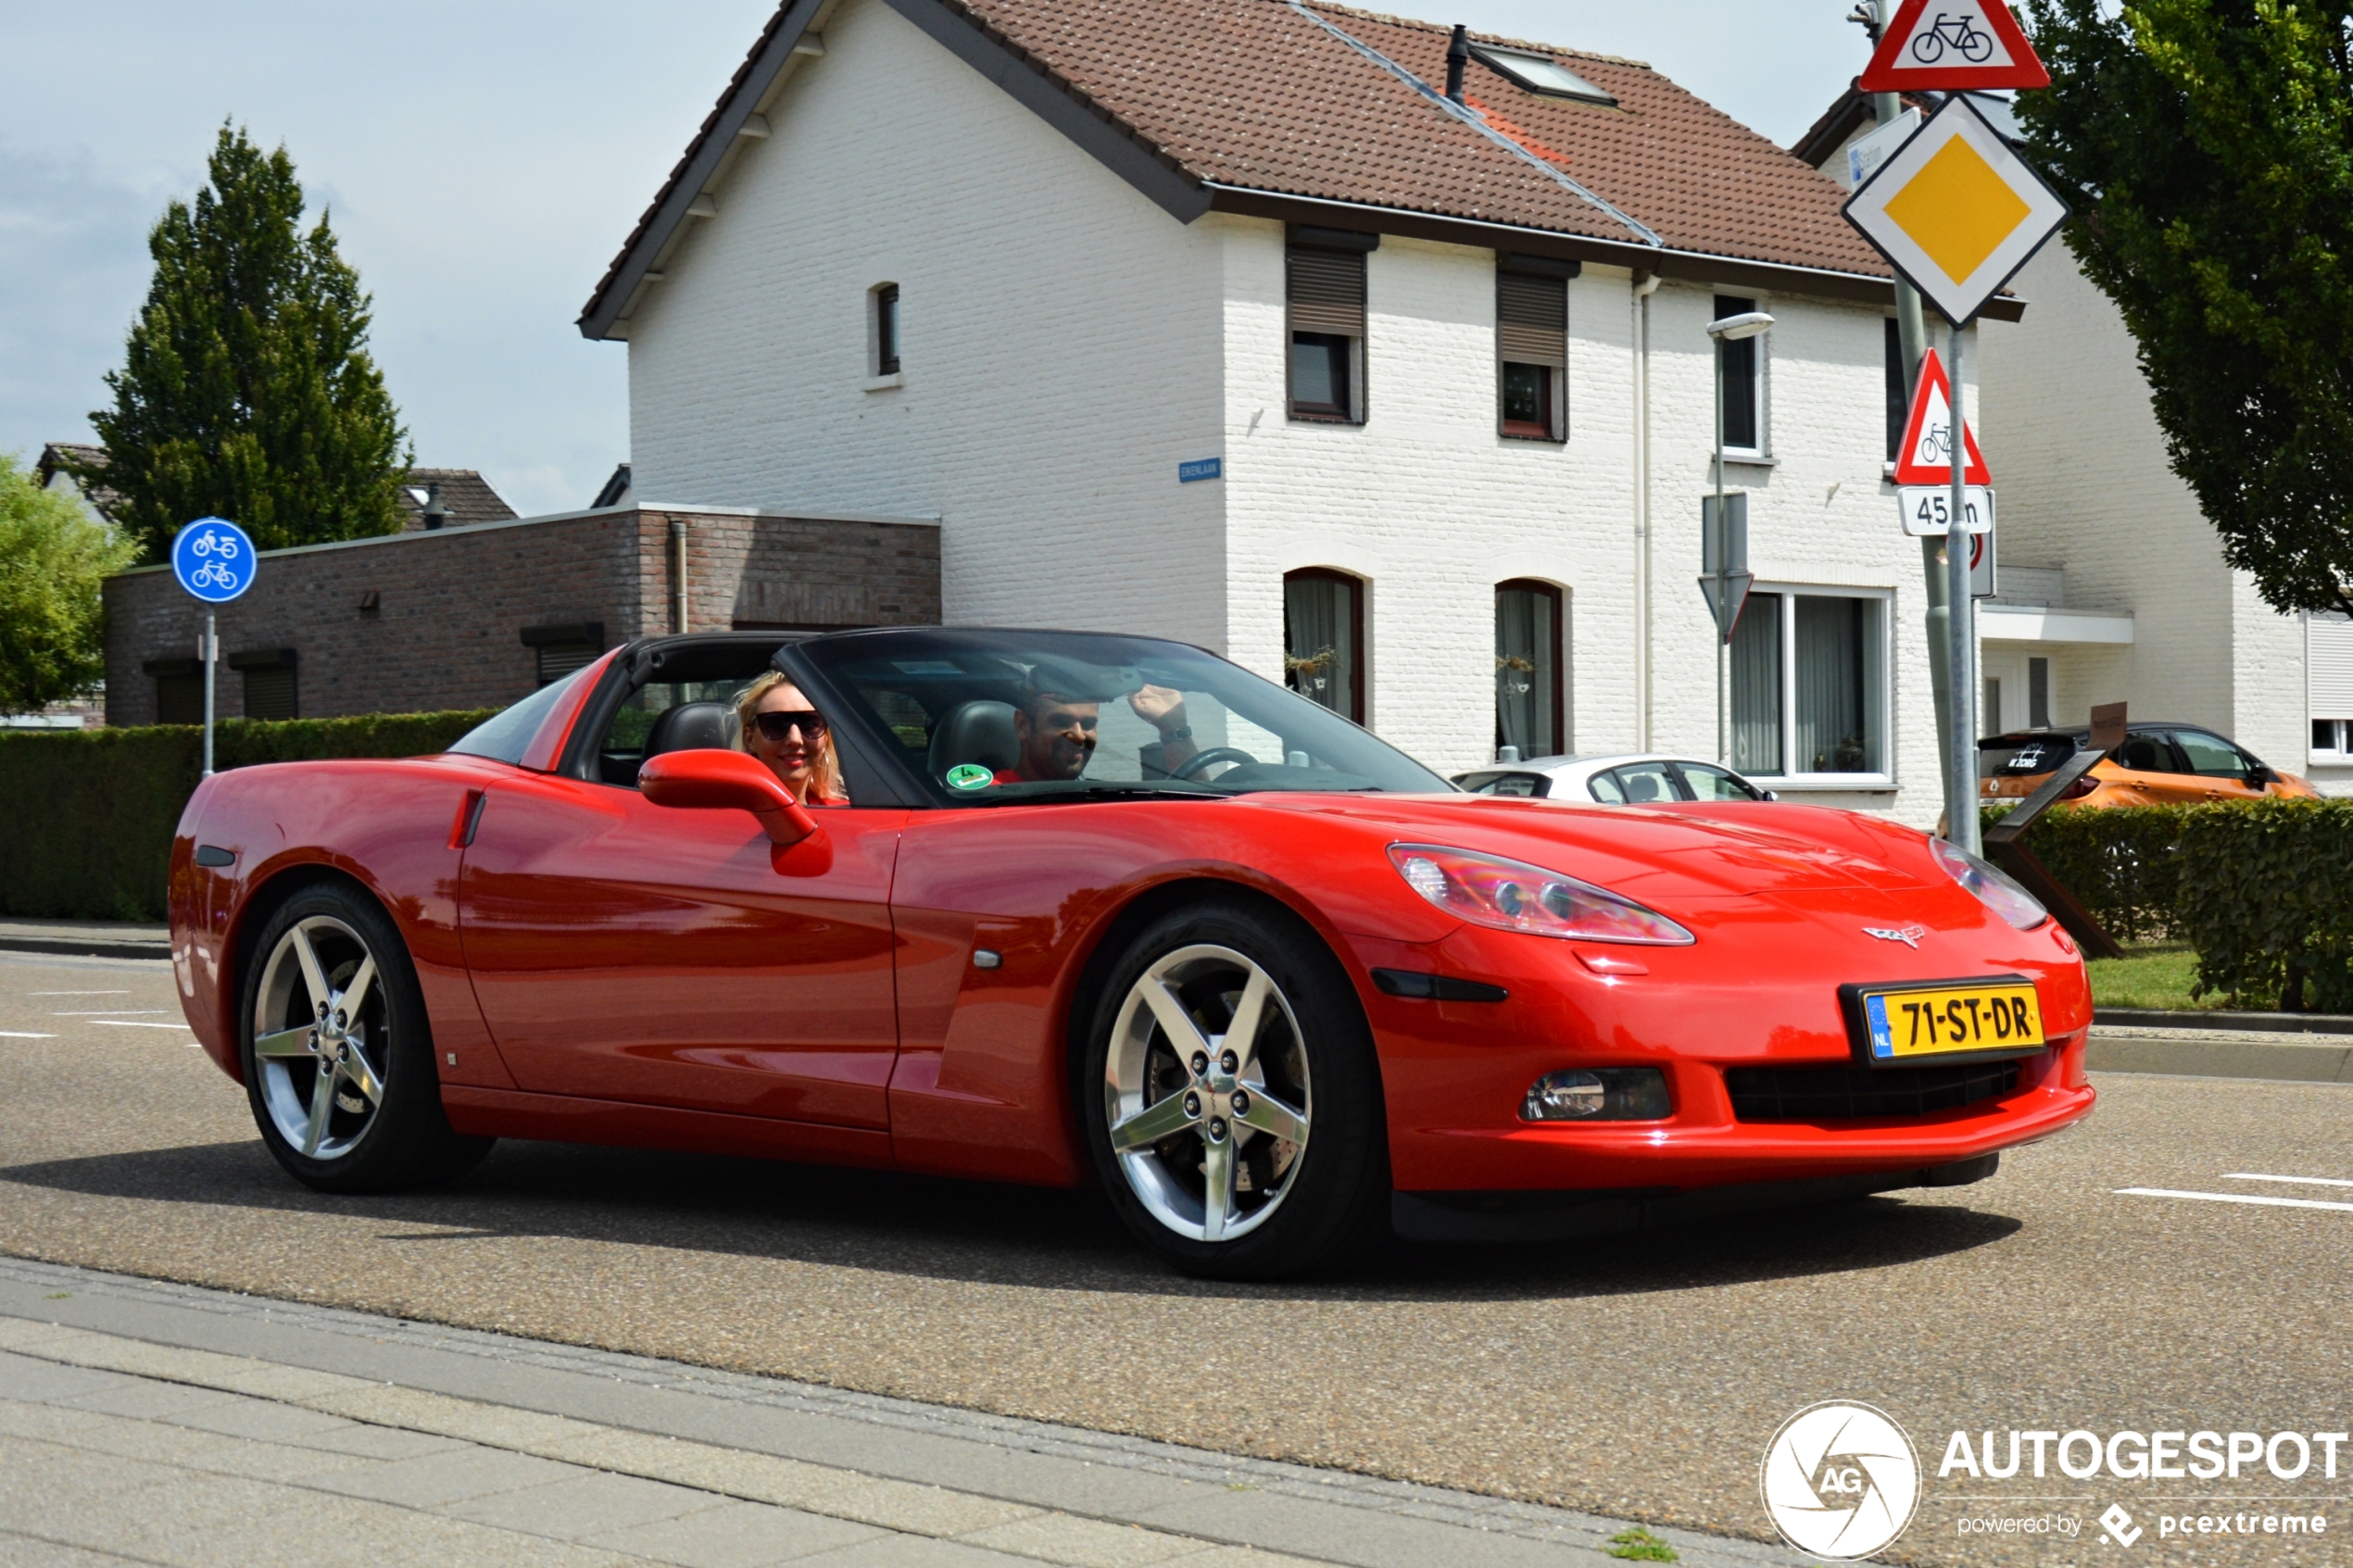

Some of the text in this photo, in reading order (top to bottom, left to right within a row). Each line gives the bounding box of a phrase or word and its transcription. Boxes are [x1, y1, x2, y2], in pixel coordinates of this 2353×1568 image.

[1181, 463, 1216, 478] EIKENLAAN
[1918, 496, 1948, 524] 45
[2016, 758, 2038, 768] ZORG
[1902, 997, 2032, 1047] 71-ST-DR
[1875, 1033, 1889, 1047] NL
